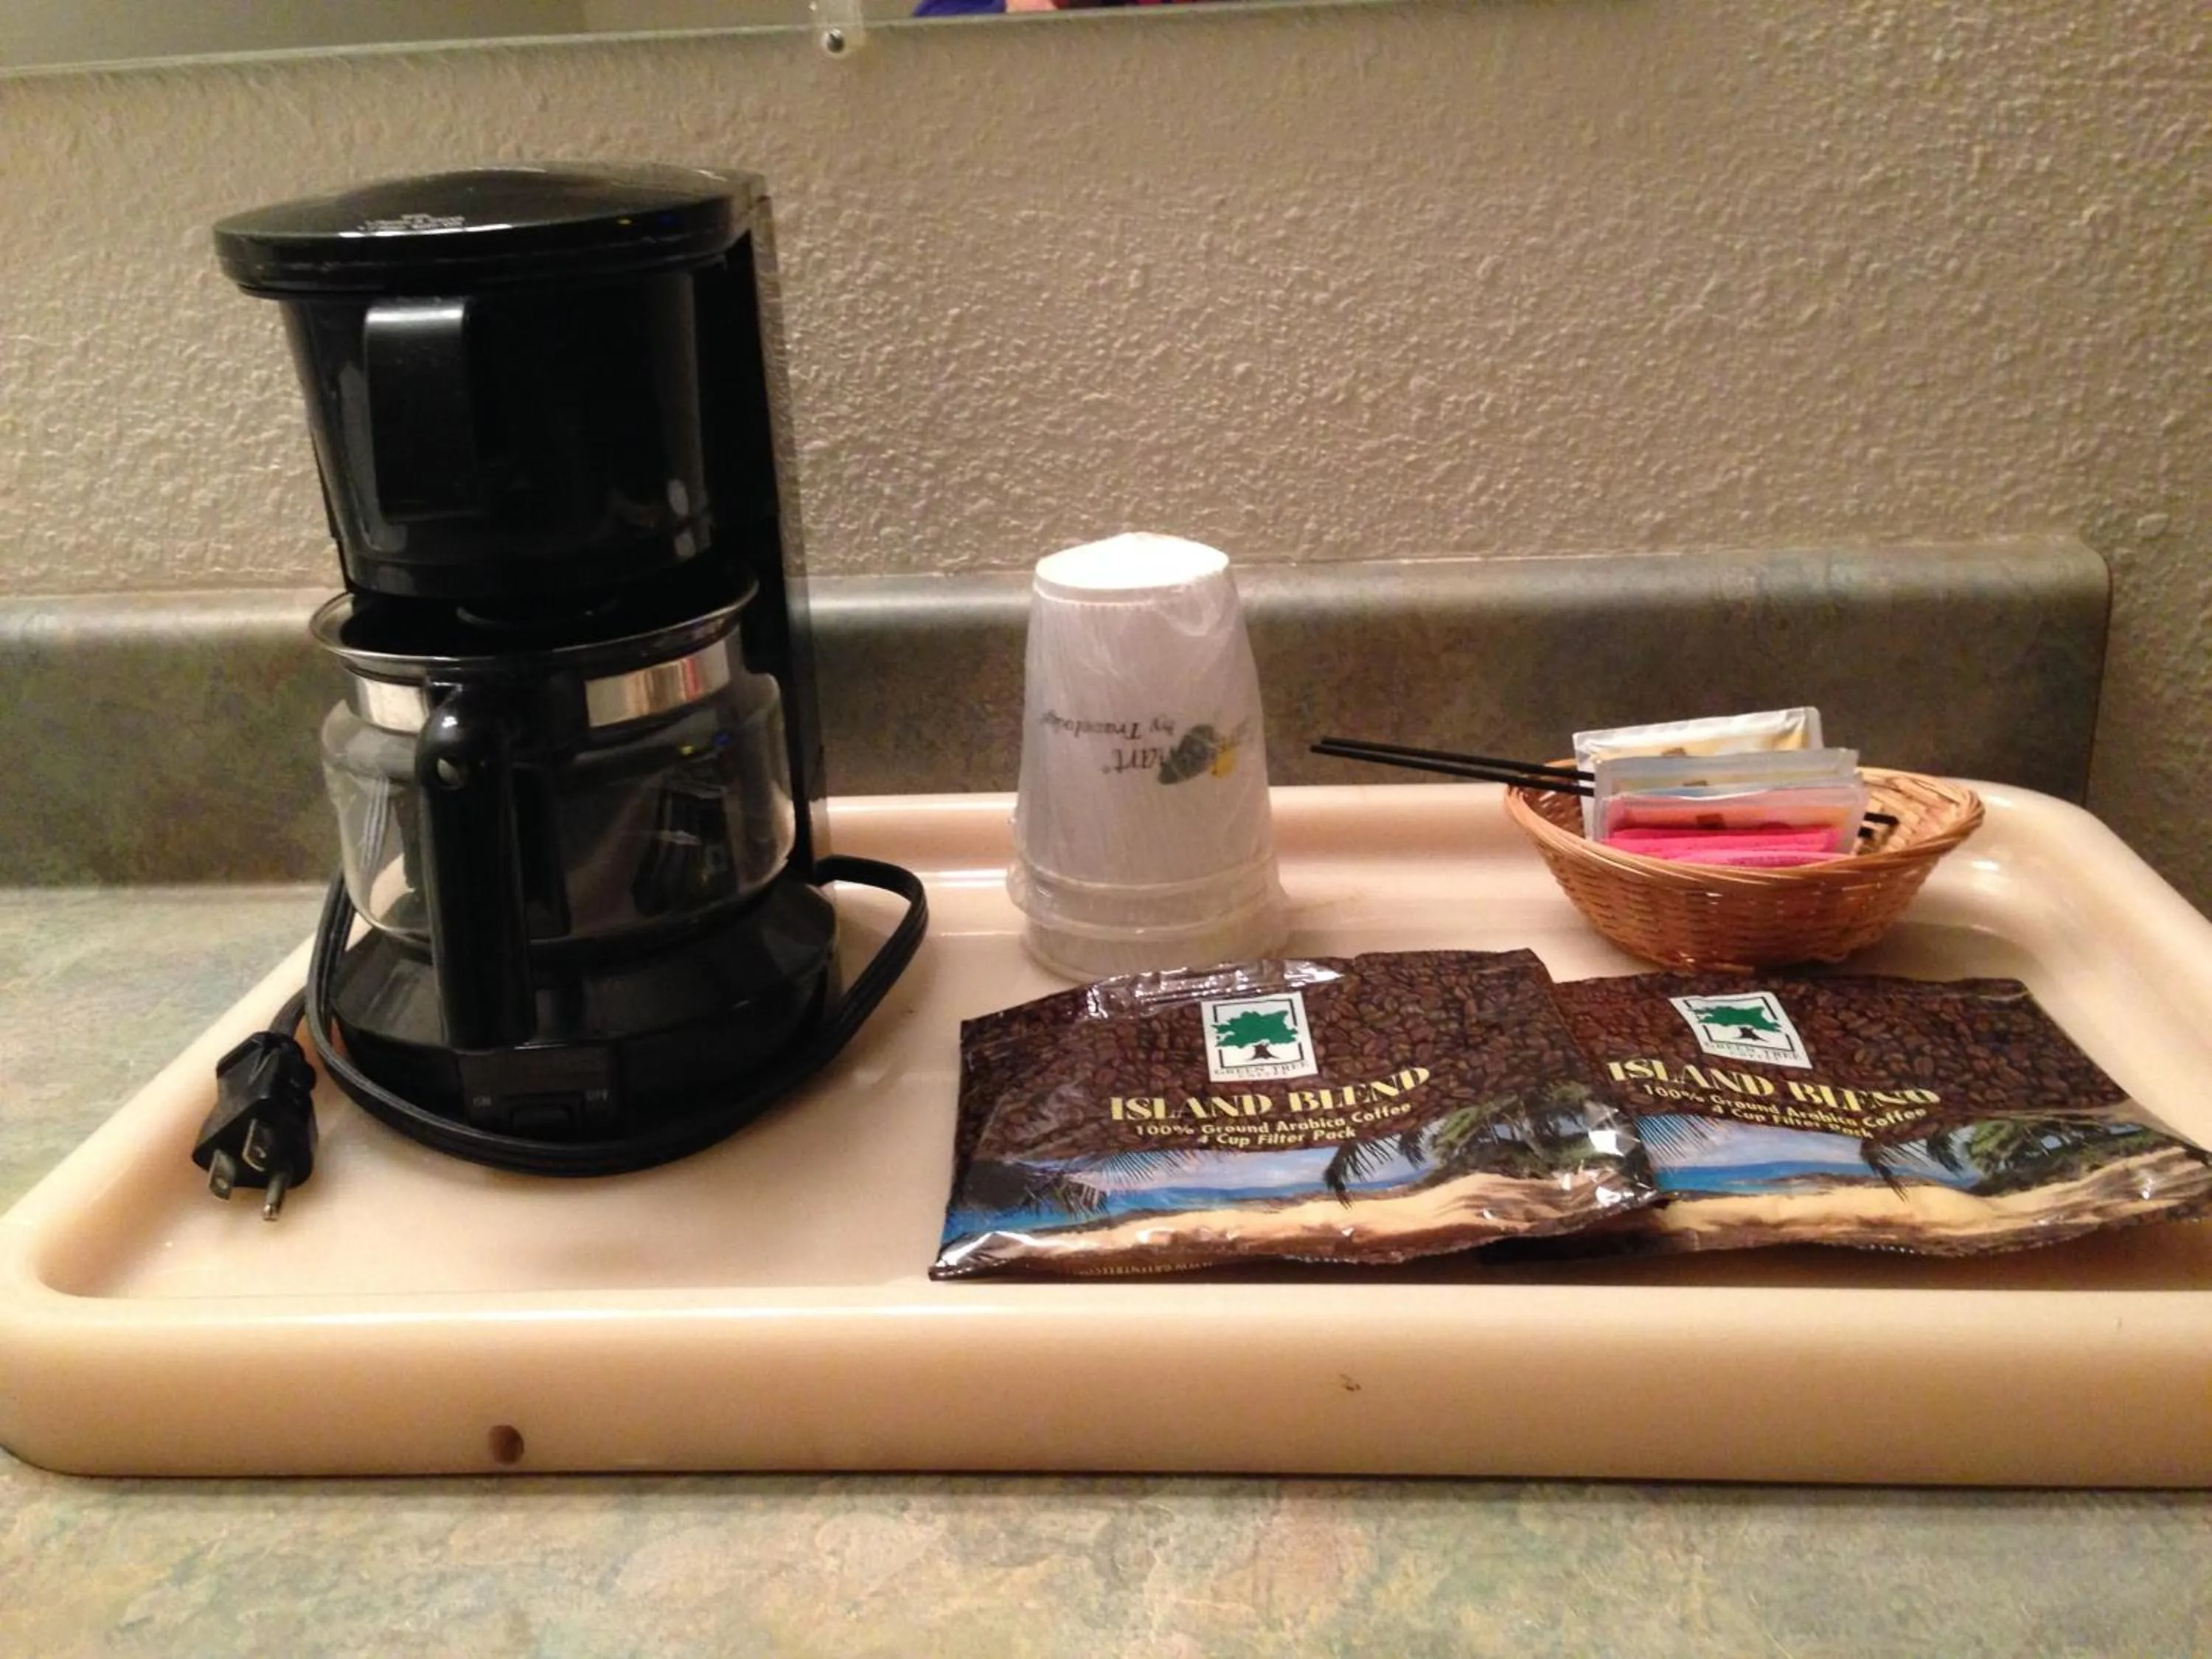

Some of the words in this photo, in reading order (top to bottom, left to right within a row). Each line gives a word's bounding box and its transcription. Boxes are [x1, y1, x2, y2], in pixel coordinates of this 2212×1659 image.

[1110, 1093, 1273, 1121] ISLAND
[1289, 1067, 1430, 1113] BLEND
[1607, 1058, 1774, 1095] ISLAND
[1787, 1080, 1941, 1112] BLEND
[1136, 1124, 1194, 1135] 100%
[1200, 1121, 1269, 1135] Ground
[1276, 1117, 1346, 1133] Arabica
[1351, 1103, 1411, 1123] Coffee
[1644, 1084, 1705, 1103] 100%
[1710, 1094, 1779, 1115] Ground
[1862, 1108, 1927, 1128] Coffee
[1711, 1105, 1724, 1114] 4
[1733, 1108, 1765, 1122] Cup
[1197, 1135, 1208, 1144] 4
[1217, 1133, 1251, 1147] Cup
[1257, 1132, 1305, 1144] Filter
[1313, 1126, 1357, 1141] Pack
